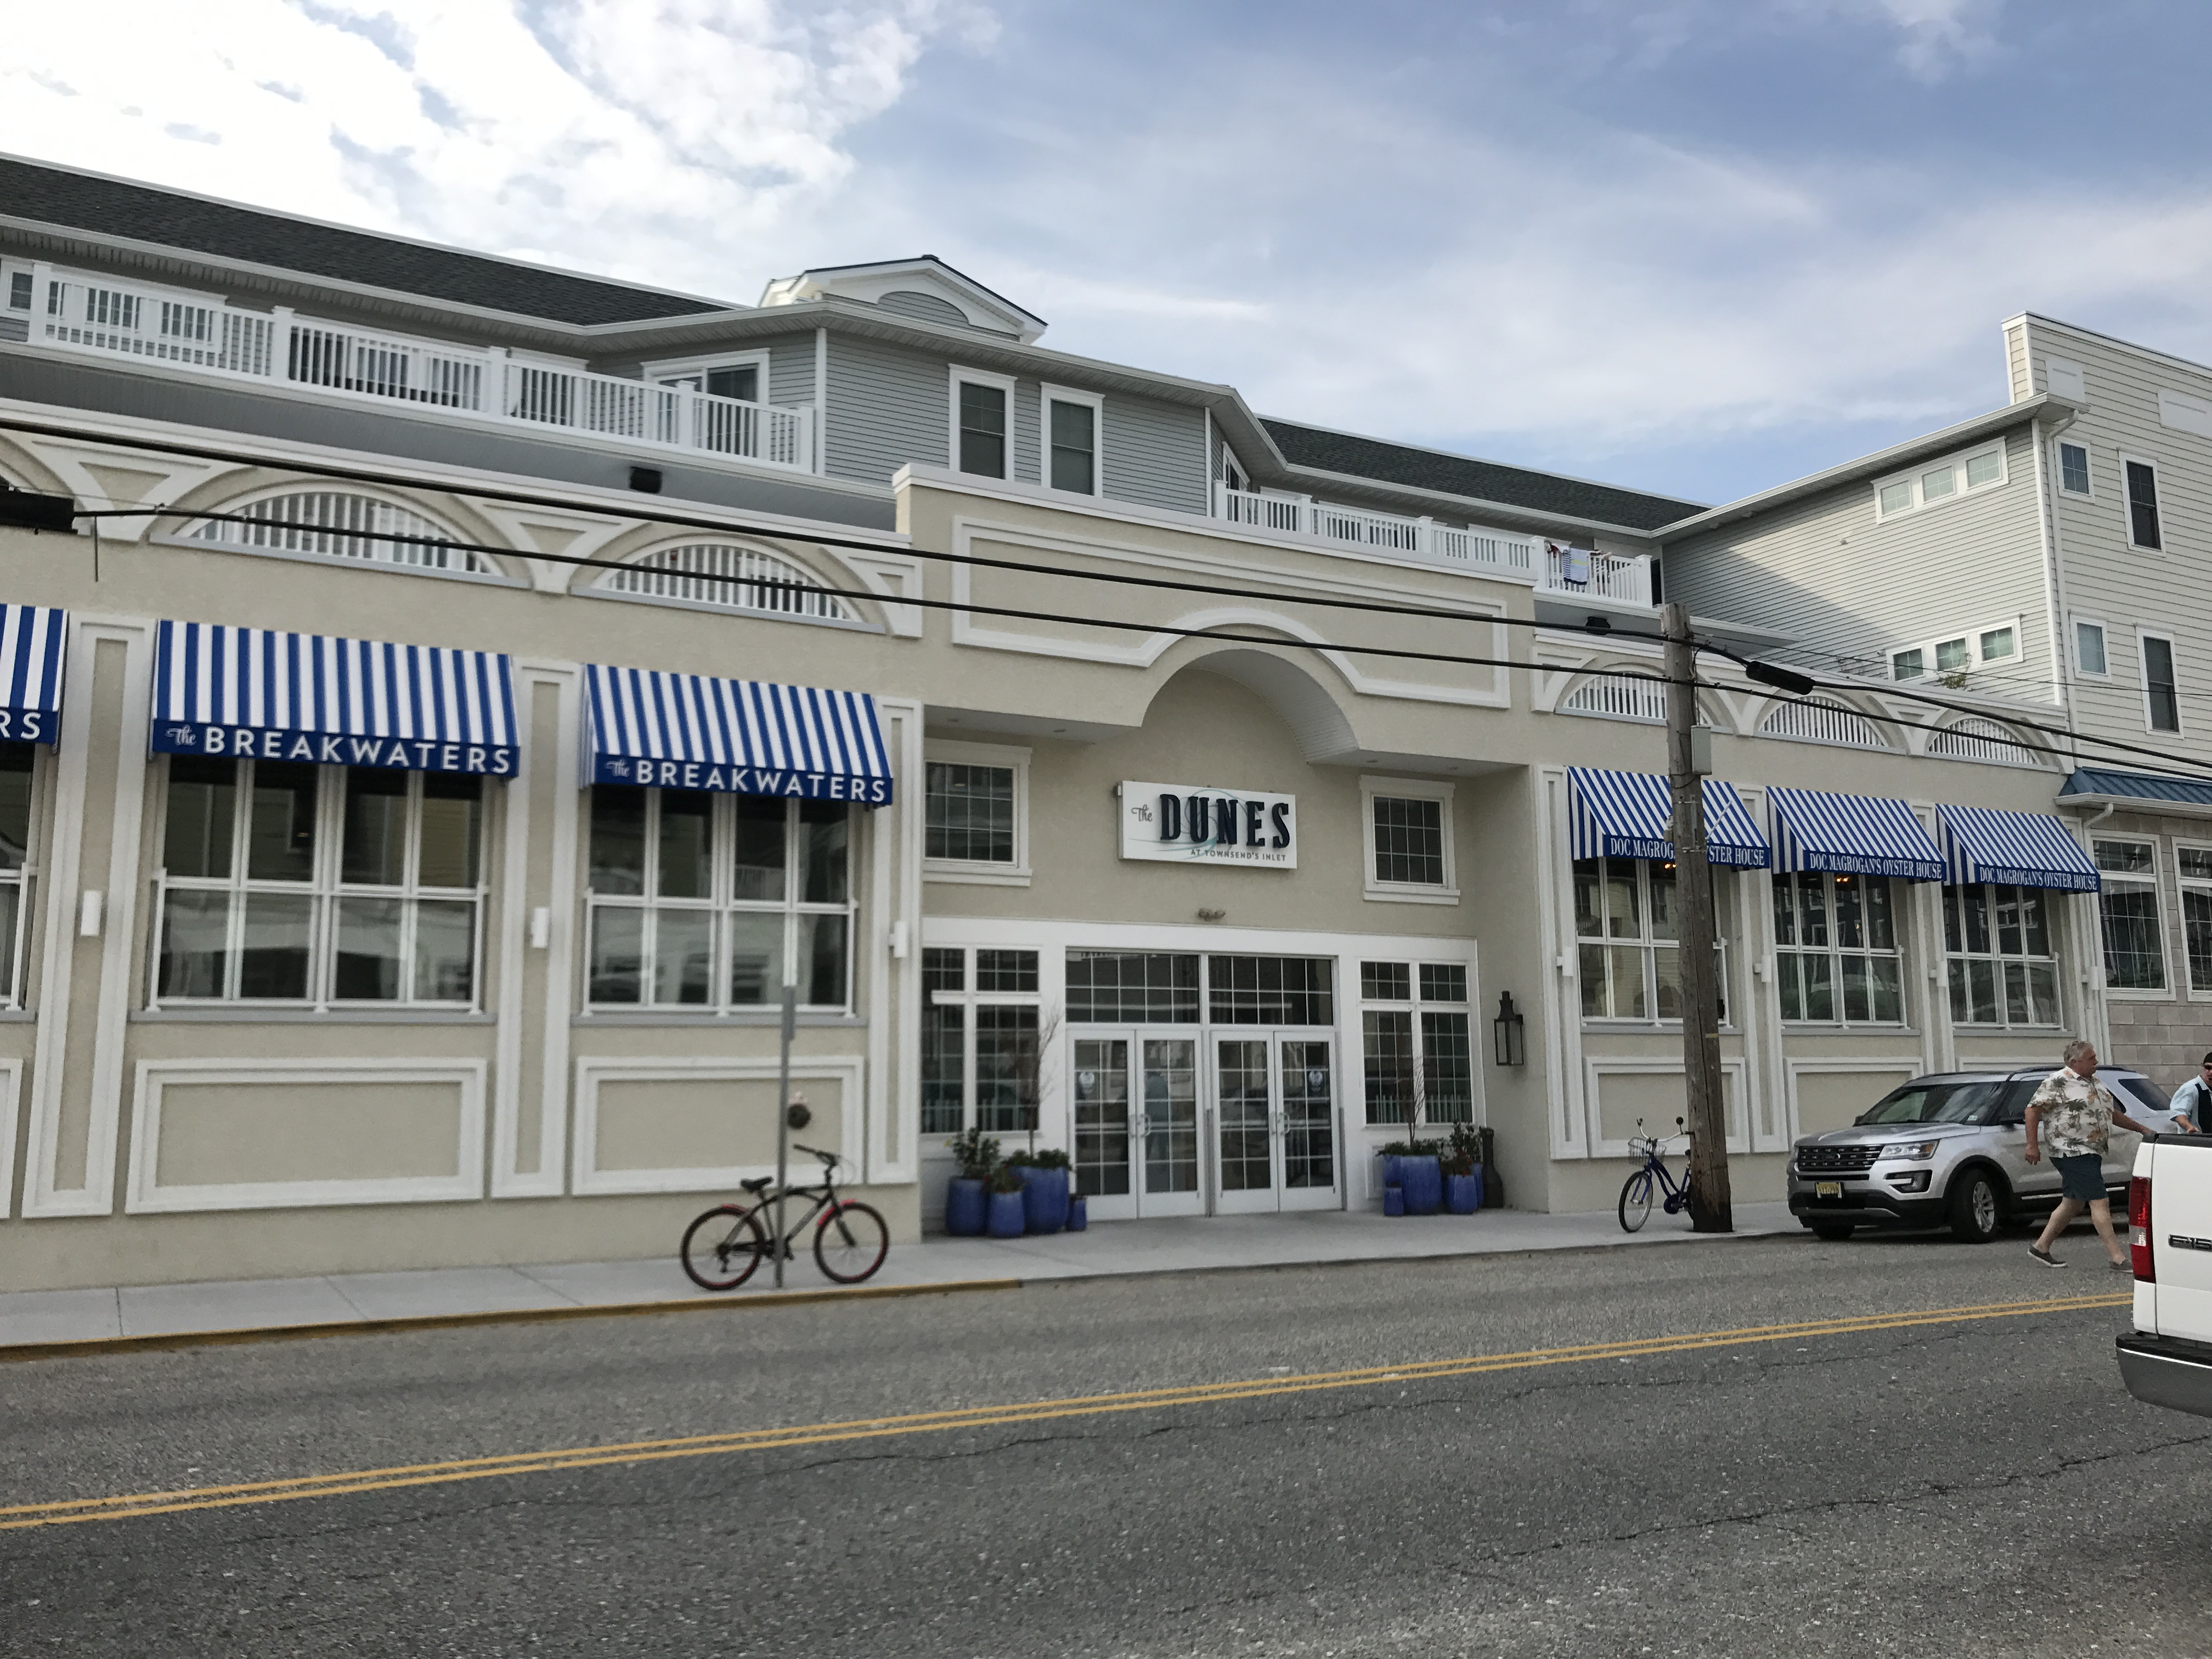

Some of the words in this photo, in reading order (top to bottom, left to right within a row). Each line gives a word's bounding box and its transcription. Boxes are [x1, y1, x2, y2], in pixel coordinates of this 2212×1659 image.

[166, 724, 196, 745] The
[204, 726, 510, 774] BREAKWATERS
[605, 759, 630, 777] The
[635, 760, 885, 802] BREAKWATERS
[1131, 804, 1153, 822] The
[1159, 793, 1290, 848] DUNES
[1205, 850, 1259, 860] TOWNSEND'S
[1262, 854, 1286, 862] INLET
[1610, 838, 1630, 856] DOC
[1633, 839, 1675, 859] MAGROG
[1735, 849, 1765, 866] HOUSE
[1809, 853, 1827, 870] DOC
[1830, 855, 1881, 875] MAGROGAN'S
[1883, 859, 1914, 877] OYSTER
[1916, 862, 1942, 879] HOUSE
[1979, 867, 1995, 883] DOC
[1997, 868, 2043, 887] MAGROGAN'S
[2045, 872, 2072, 888] OYSTER
[2074, 874, 2097, 890] HOUSE
